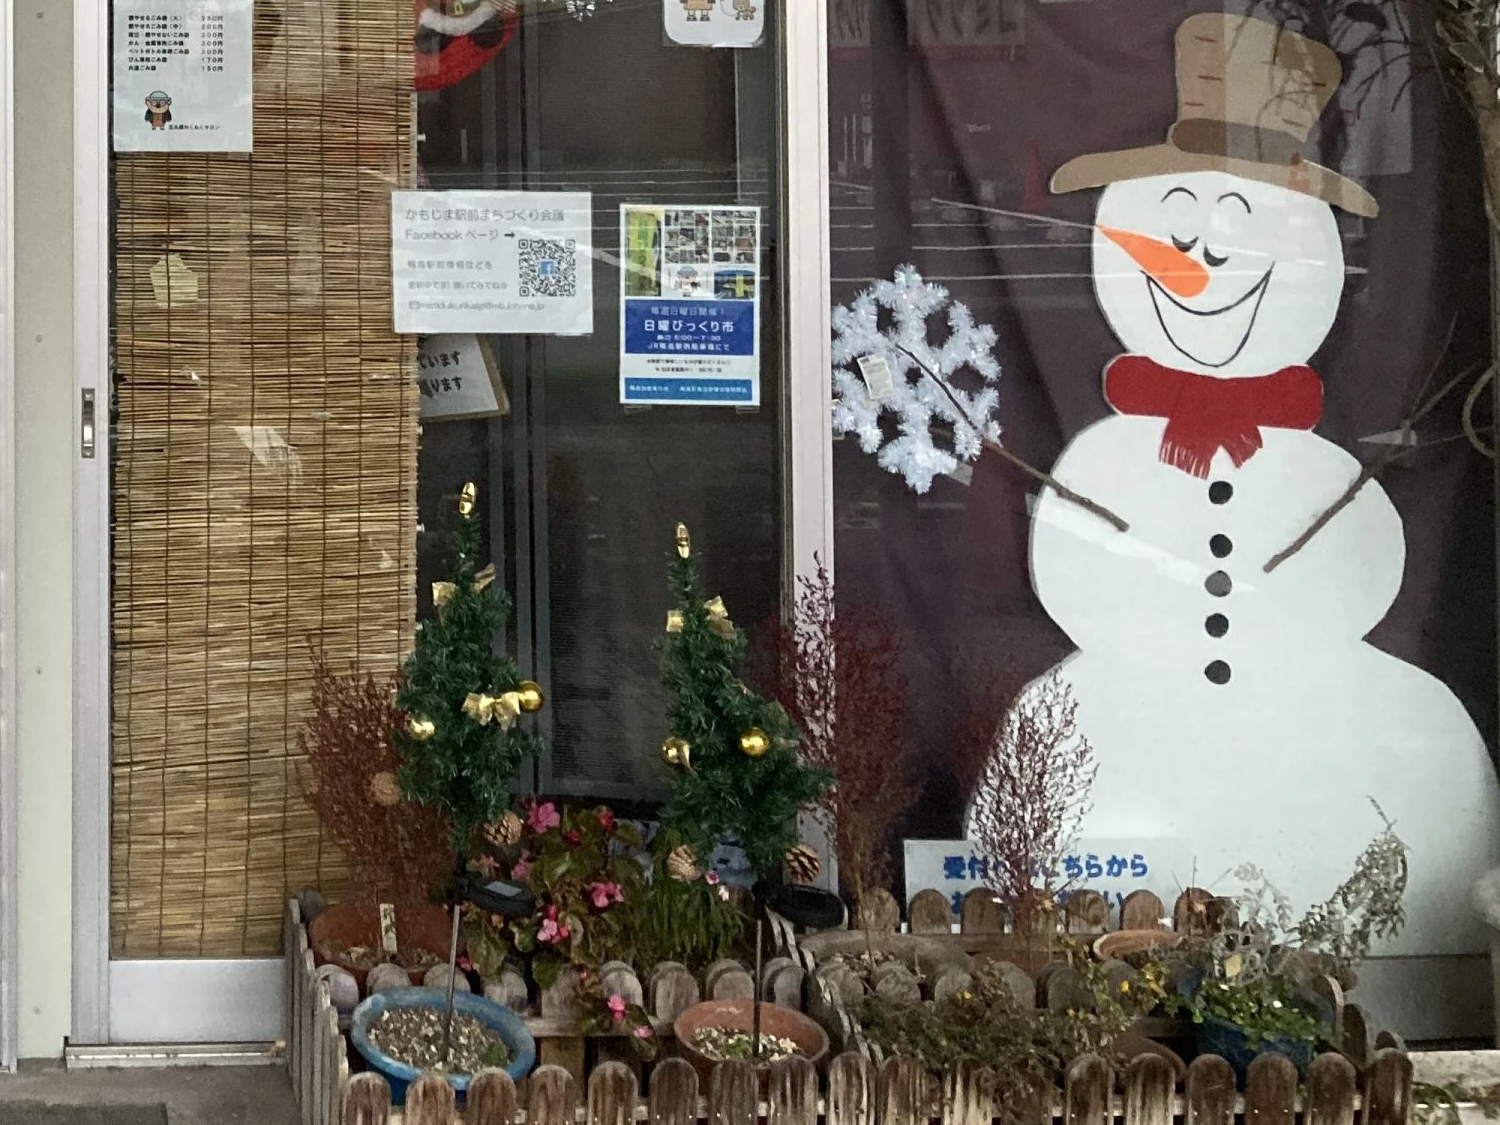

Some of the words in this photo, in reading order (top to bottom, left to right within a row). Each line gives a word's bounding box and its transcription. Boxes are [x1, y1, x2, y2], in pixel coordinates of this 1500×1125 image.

[405, 209, 564, 222] かもじま駅前まちづくり会議
[405, 229, 462, 241] Facebook
[465, 230, 499, 241] ページ
[644, 320, 734, 333] 日曜びっくり市
